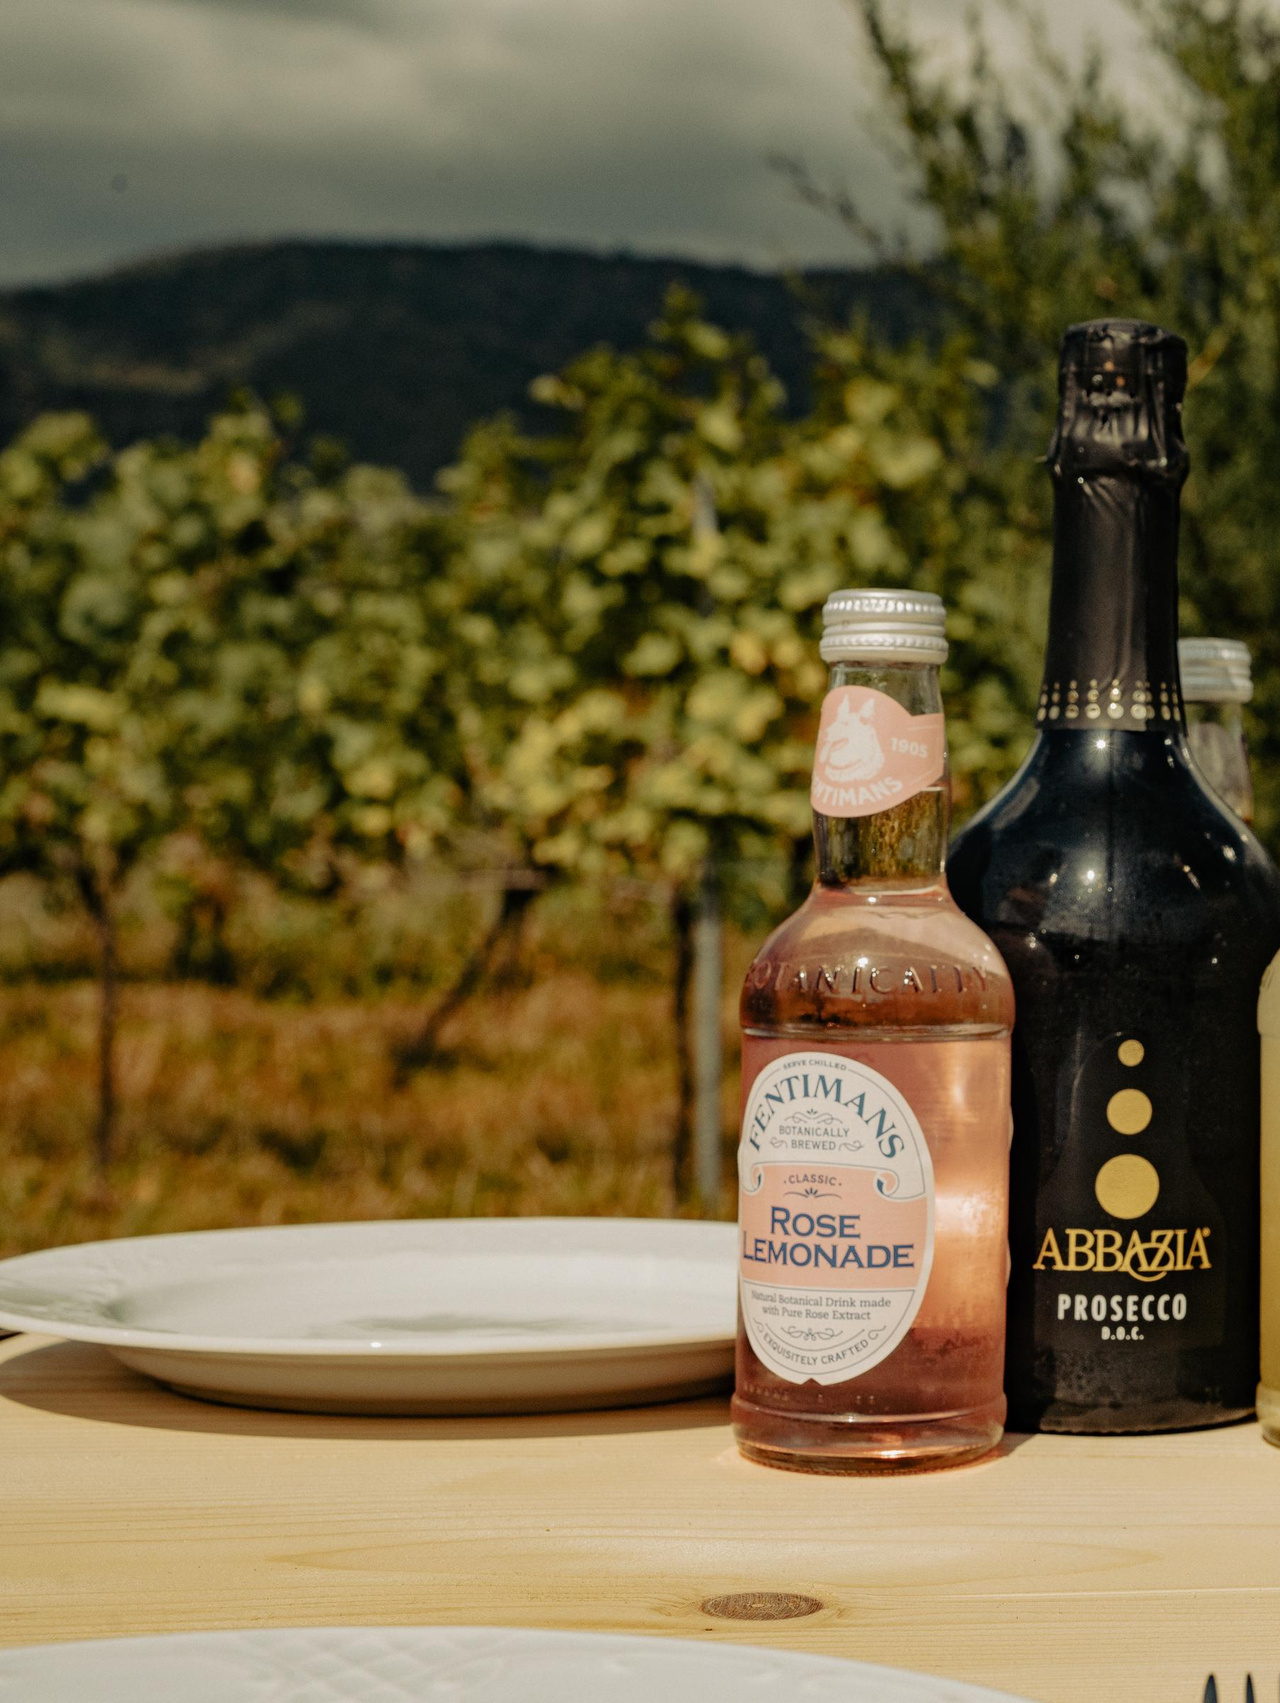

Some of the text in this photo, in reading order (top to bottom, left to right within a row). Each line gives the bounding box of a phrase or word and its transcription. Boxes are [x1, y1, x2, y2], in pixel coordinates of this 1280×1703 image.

[890, 737, 929, 759] 1905
[811, 776, 903, 807] NTIMANS
[740, 960, 989, 994] OTANICALLY
[782, 1058, 847, 1072] SERVE CHILLED
[749, 1073, 905, 1160] FENTIMANS
[779, 1125, 850, 1138] BOTANICALLY
[791, 1140, 836, 1151] BREWED
[788, 1173, 838, 1187] CLASSIC
[770, 1206, 861, 1239] ROSE
[743, 1230, 915, 1269] LEMONADE
[1032, 1227, 1212, 1282] ABBAZIA
[751, 1290, 891, 1309] Natural Botanical Drink made
[1057, 1293, 1188, 1322] PROSECCO
[762, 1305, 871, 1321] with Pure Rose Extract
[1101, 1325, 1145, 1341] D.O.C.
[762, 1332, 869, 1366] EXQUISITELY CRAFTED
